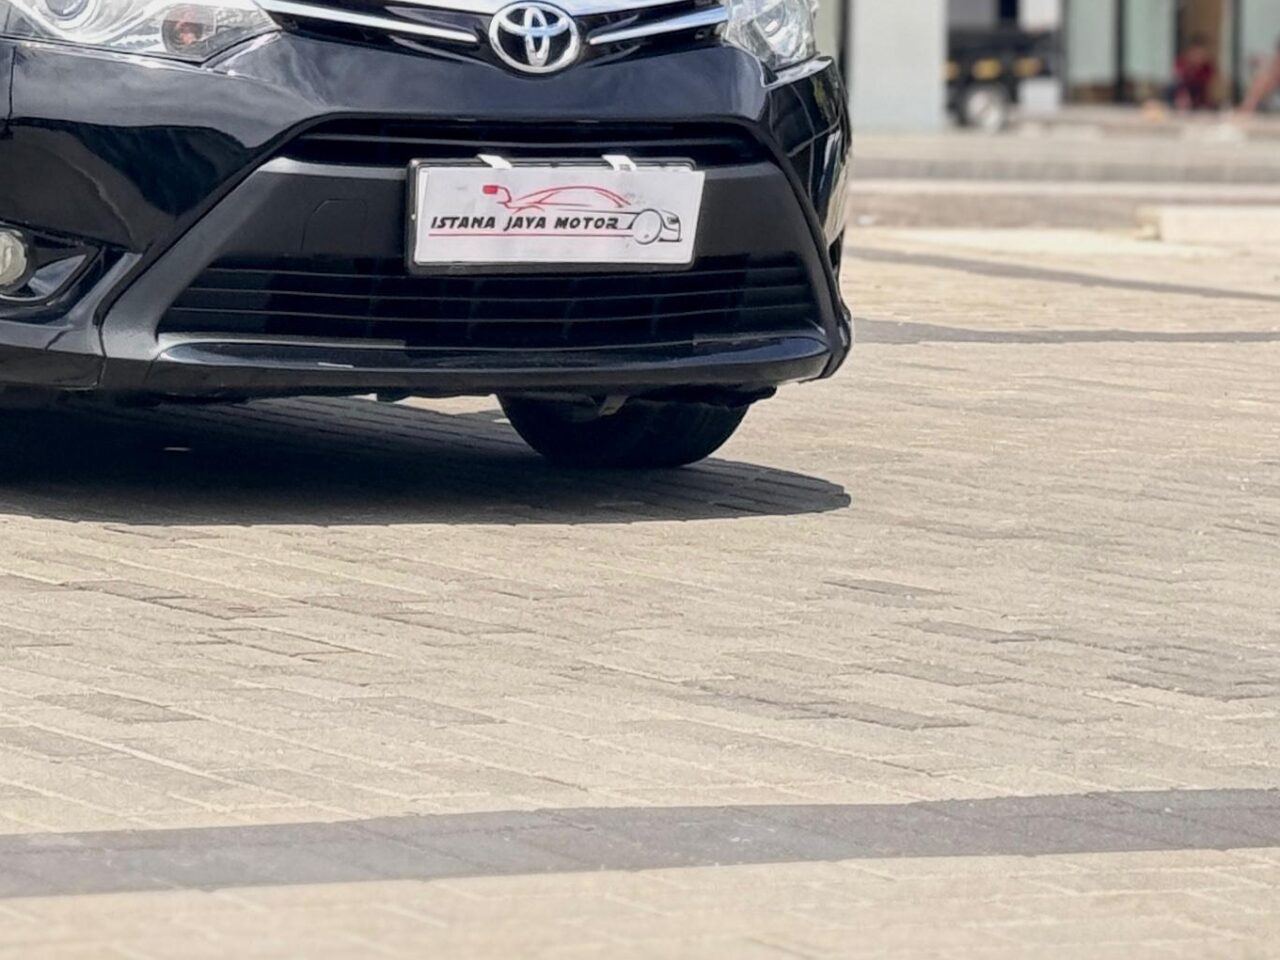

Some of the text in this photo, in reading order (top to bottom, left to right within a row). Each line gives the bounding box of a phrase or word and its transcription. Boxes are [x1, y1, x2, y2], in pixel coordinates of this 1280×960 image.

[430, 216, 620, 232] ISTANA JAYA MOTOR
